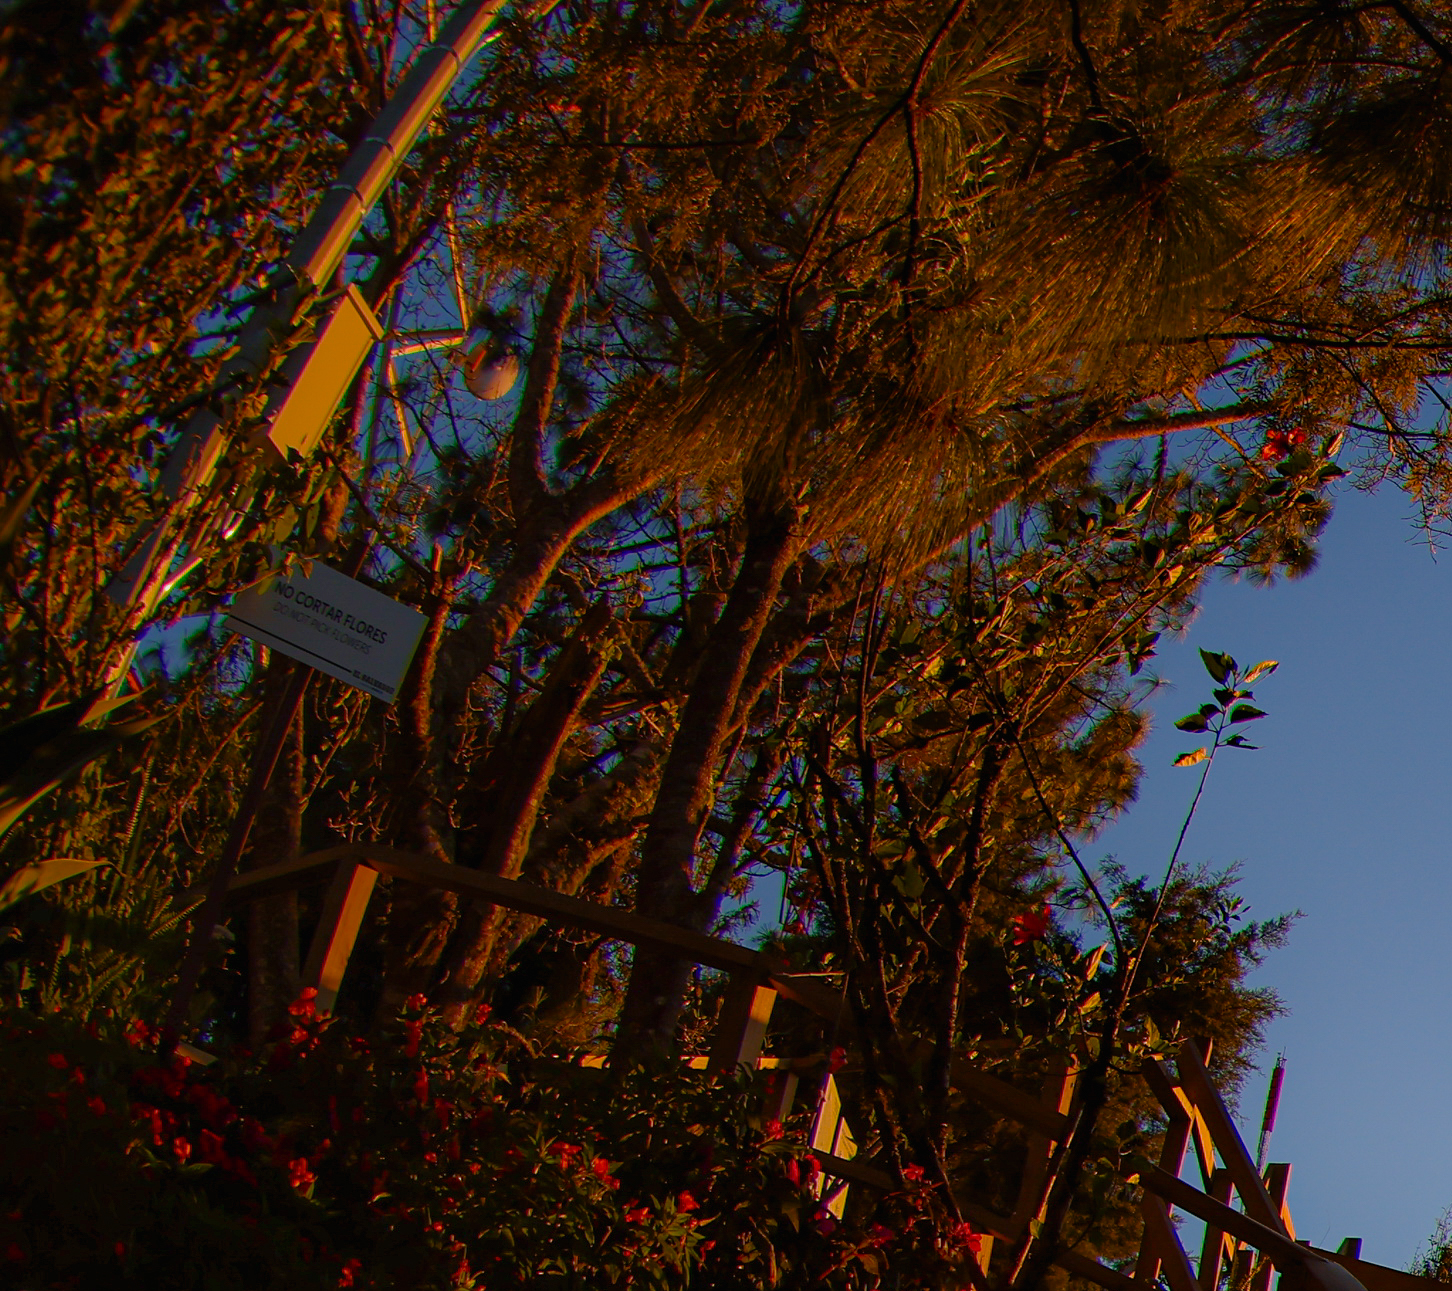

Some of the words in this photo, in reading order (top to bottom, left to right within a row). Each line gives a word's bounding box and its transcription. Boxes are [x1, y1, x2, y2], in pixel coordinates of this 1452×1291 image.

[273, 601, 290, 616] DO
[290, 609, 311, 623] NOT
[311, 617, 333, 634] PICK
[332, 629, 372, 655] FLOWERS
[275, 581, 295, 599] NO
[295, 592, 343, 623] CORTAR
[343, 614, 388, 645] FLORES
